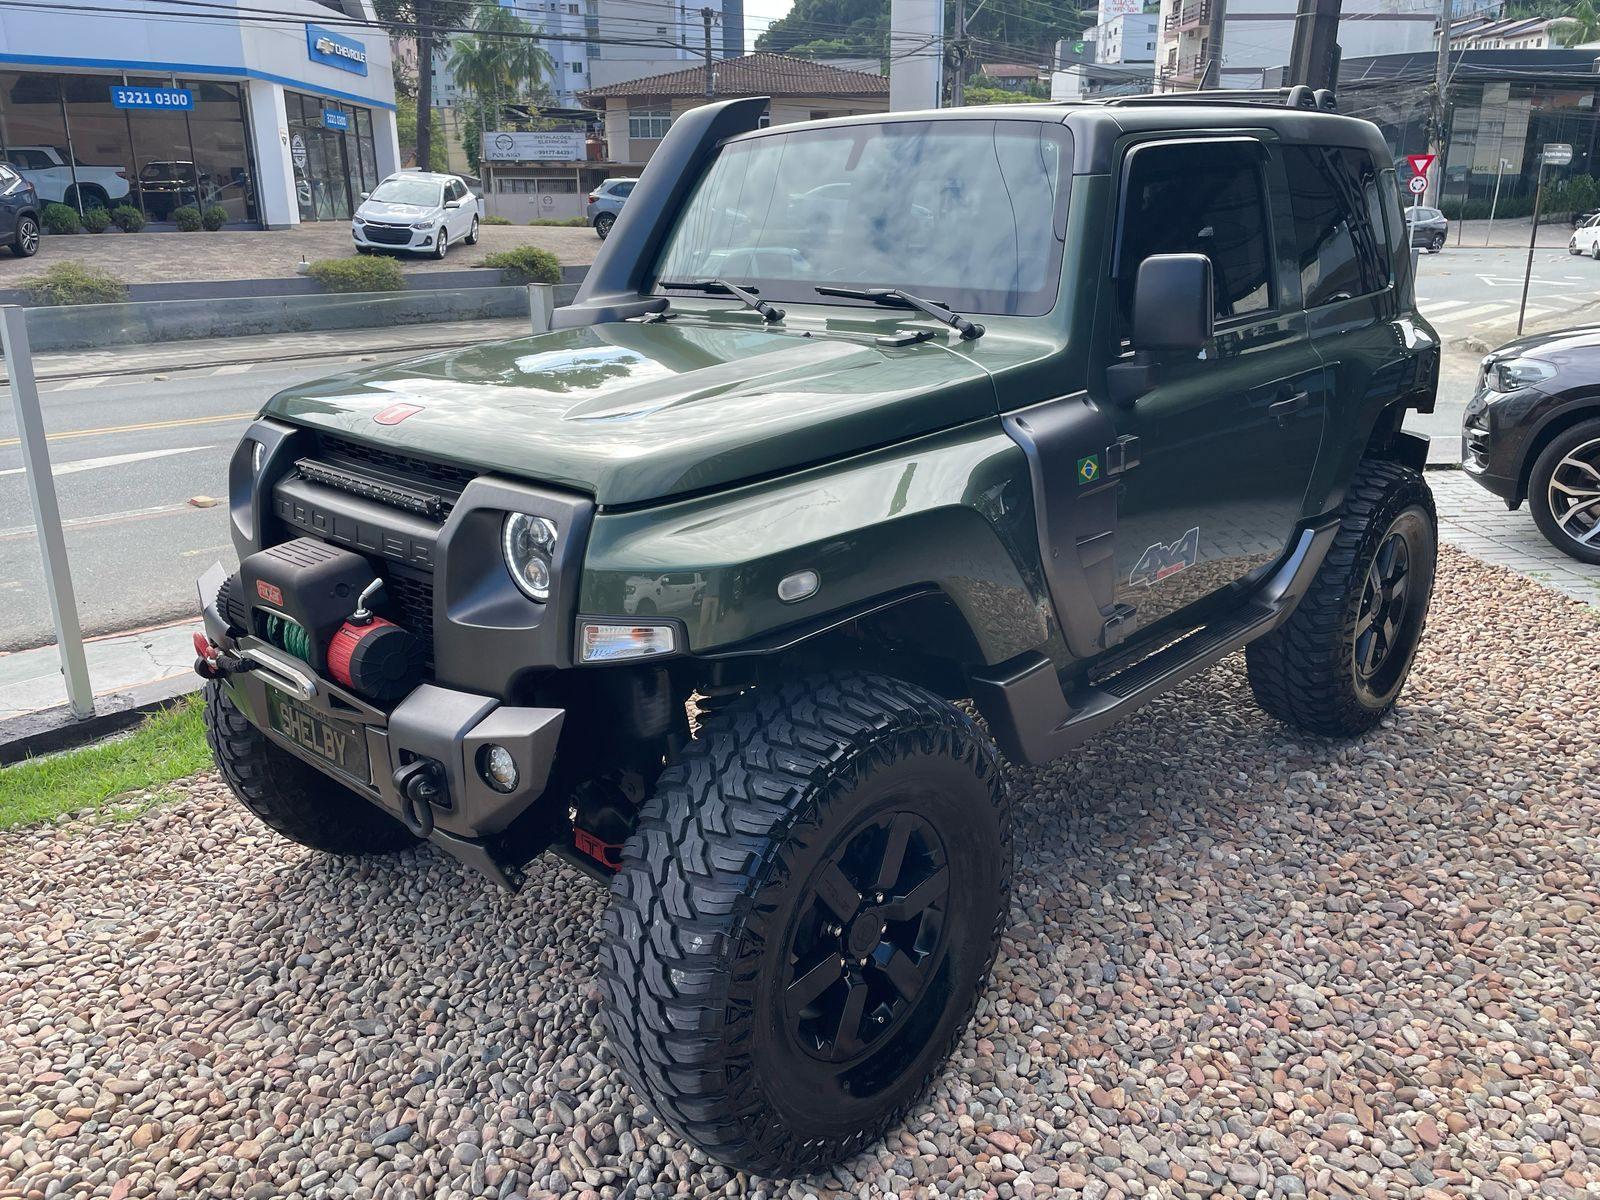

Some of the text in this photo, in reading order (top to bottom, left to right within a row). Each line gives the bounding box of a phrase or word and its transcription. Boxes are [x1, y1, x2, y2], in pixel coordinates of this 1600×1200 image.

[335, 44, 368, 63] CHEVROLET
[118, 91, 188, 106] 3221 0300
[278, 499, 434, 567] TROLLER
[279, 702, 346, 766] SHELBY
